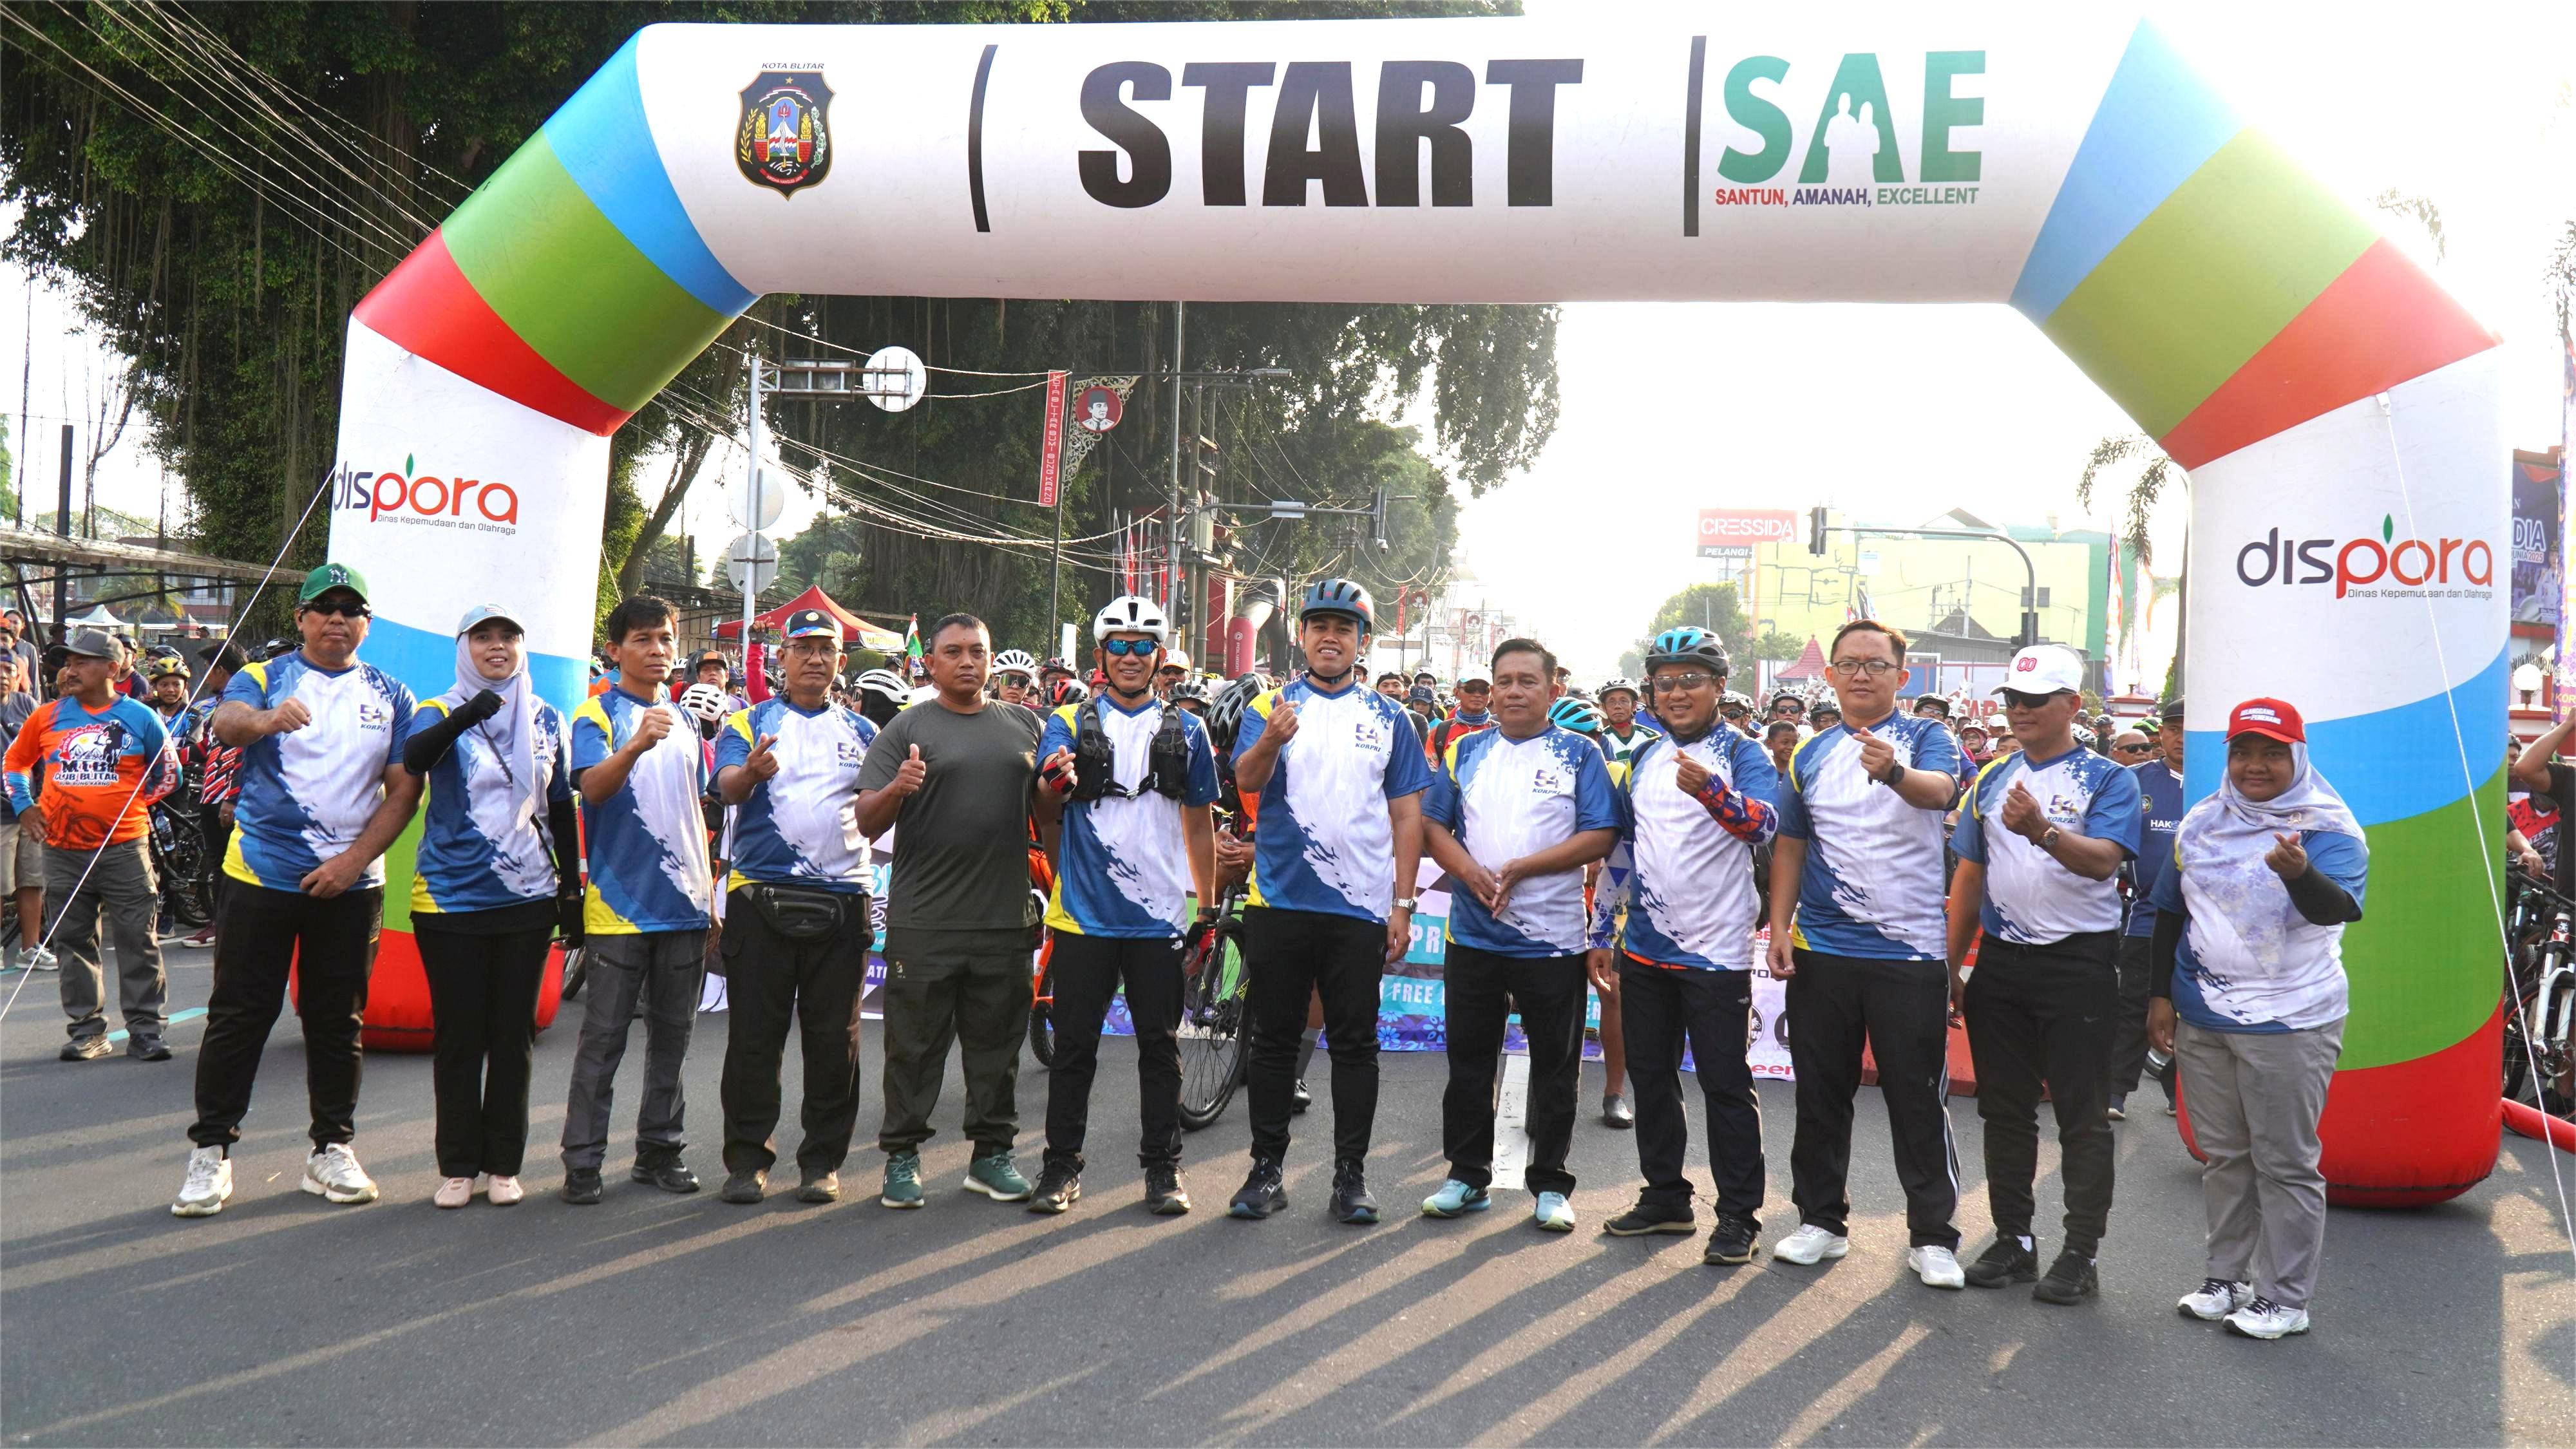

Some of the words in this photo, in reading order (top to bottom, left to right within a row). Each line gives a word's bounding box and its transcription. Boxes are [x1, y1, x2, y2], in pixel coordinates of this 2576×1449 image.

[1716, 50, 1985, 184] SAE
[1078, 59, 1584, 208] START
[1716, 188, 1788, 207] SANTUN,
[1792, 188, 1871, 207] AMANAH,
[1877, 187, 1980, 205] EXCELLENT
[1050, 397, 1059, 428] BLITAR
[1048, 430, 1057, 451] BUMI
[1046, 453, 1055, 475] BUNG
[334, 460, 518, 525] dispora
[1044, 477, 1054, 503] KARNO
[378, 515, 398, 524] Dinas
[401, 516, 456, 528] Kepemudaan
[459, 520, 475, 530] dan
[478, 523, 516, 535] Olahraga
[1701, 518, 1795, 536] CRESSIDA
[1705, 547, 1748, 556] PELANGI
[2528, 551, 2544, 563] 2025
[2237, 527, 2492, 599] dispora
[2348, 589, 2378, 598] Dinas
[2447, 589, 2462, 598] dan
[2465, 589, 2492, 600] Olahraga
[361, 704, 388, 724] 54
[1355, 723, 1381, 744] 54
[837, 742, 864, 761] 54
[1355, 743, 1381, 752] KORPRI
[80, 773, 118, 781] BLITAR
[1534, 770, 1562, 788] 54
[2049, 795, 2078, 815] 54
[1392, 983, 1433, 1004] FREE
